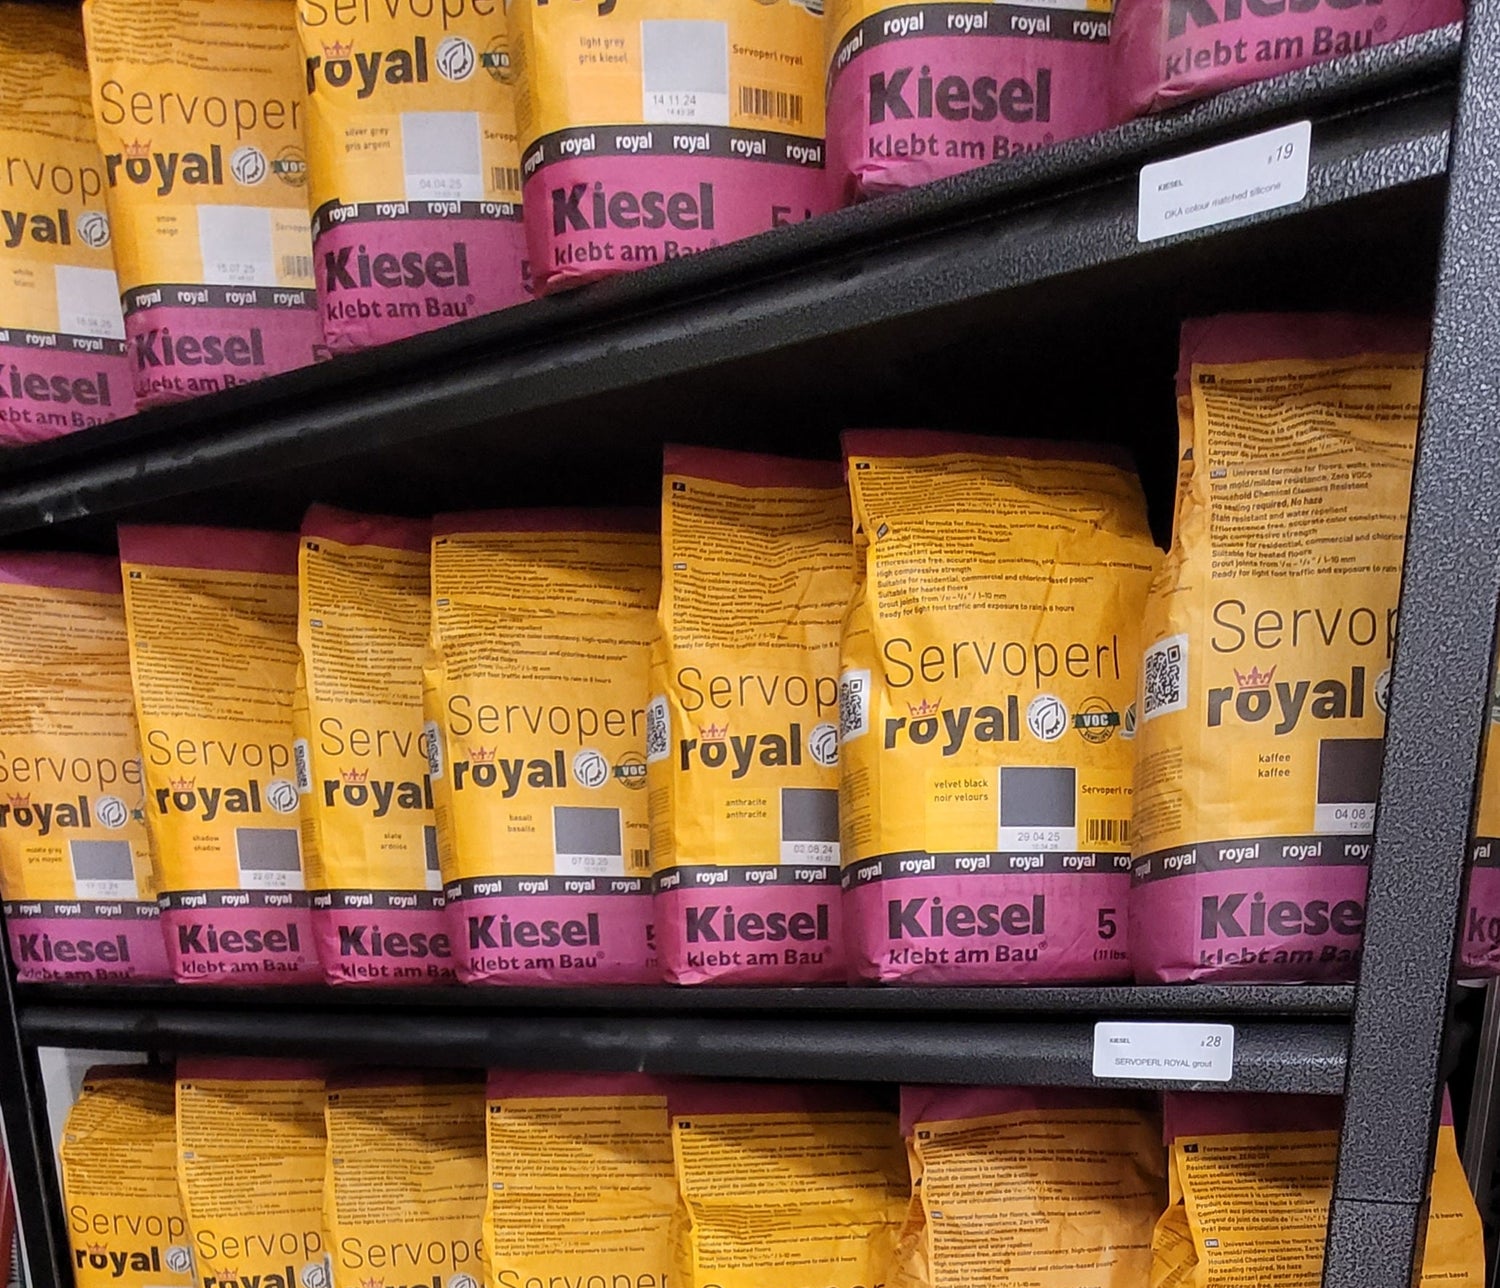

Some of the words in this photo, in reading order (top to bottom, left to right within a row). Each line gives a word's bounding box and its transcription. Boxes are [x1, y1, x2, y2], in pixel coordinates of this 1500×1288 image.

[579, 53, 596, 64] gris
[600, 53, 628, 63] kiesel
[604, 38, 624, 48] grey
[732, 44, 778, 60] Servoperl
[1165, 39, 1247, 80] klebt
[1255, 34, 1303, 61] am
[306, 36, 428, 99] royal
[869, 66, 1051, 125] Kiesel
[345, 141, 360, 152] gris
[371, 128, 389, 138] grey
[560, 134, 595, 154] royal
[616, 132, 652, 152] royal
[673, 133, 710, 152] royal
[730, 138, 766, 158] royal
[786, 144, 820, 162] royal
[105, 143, 223, 196] royal
[551, 181, 714, 236] Kiesel
[1185, 203, 1210, 214] colour
[1212, 192, 1248, 206] matched
[1249, 183, 1281, 197] silicone
[324, 242, 469, 293] Kiesel
[135, 327, 265, 370] Kiesel
[884, 635, 1119, 688] Servoperl
[1207, 667, 1364, 735] royal
[884, 695, 1020, 757] royal
[1082, 715, 1109, 727] VOC
[148, 730, 289, 775] Servop
[680, 724, 802, 779] royal
[1258, 752, 1291, 763] kaffee
[453, 750, 566, 798] royal
[934, 780, 962, 790] velvet
[964, 778, 988, 789] black
[1258, 767, 1291, 778] kaffee
[156, 780, 261, 822] royal
[934, 792, 952, 802] noir
[955, 792, 988, 802] velours
[1081, 785, 1121, 795] Servoperl
[858, 861, 882, 879] royal
[900, 855, 935, 873] royal
[955, 855, 990, 871] royal
[1010, 854, 1044, 869] royal
[1063, 854, 1095, 869] royal
[1282, 842, 1322, 860] royal
[469, 912, 600, 950] Kiesel
[686, 904, 828, 944] Kiesel
[888, 895, 1045, 940] Kiesel
[1097, 908, 1117, 940] 5
[19, 934, 130, 963] Kiesel
[178, 923, 299, 956] Kiesel
[889, 946, 949, 965] klebt
[955, 948, 989, 964] am
[1115, 1058, 1162, 1066] SERVOPERL
[1192, 1060, 1212, 1068] grout
[76, 1246, 161, 1277] royal
